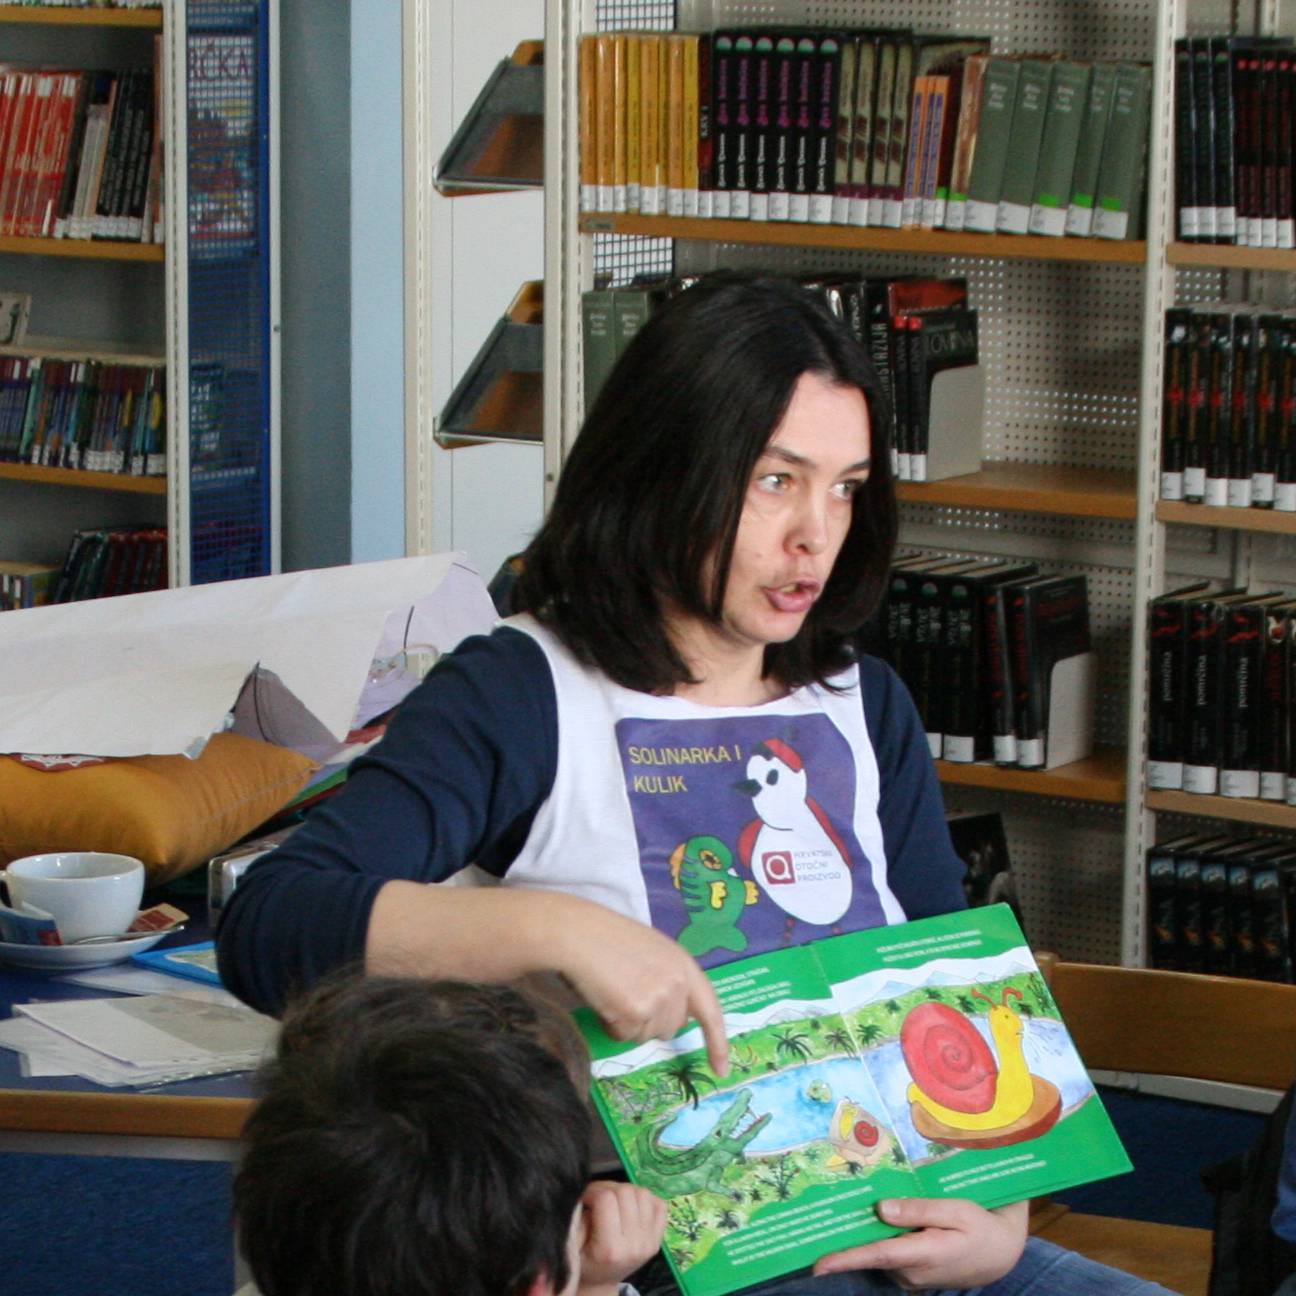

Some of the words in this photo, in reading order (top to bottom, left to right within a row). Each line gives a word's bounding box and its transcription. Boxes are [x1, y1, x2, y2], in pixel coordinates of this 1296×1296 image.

[628, 746, 732, 766] SOLINARKA
[734, 745, 742, 761] I
[633, 775, 689, 793] KULIK
